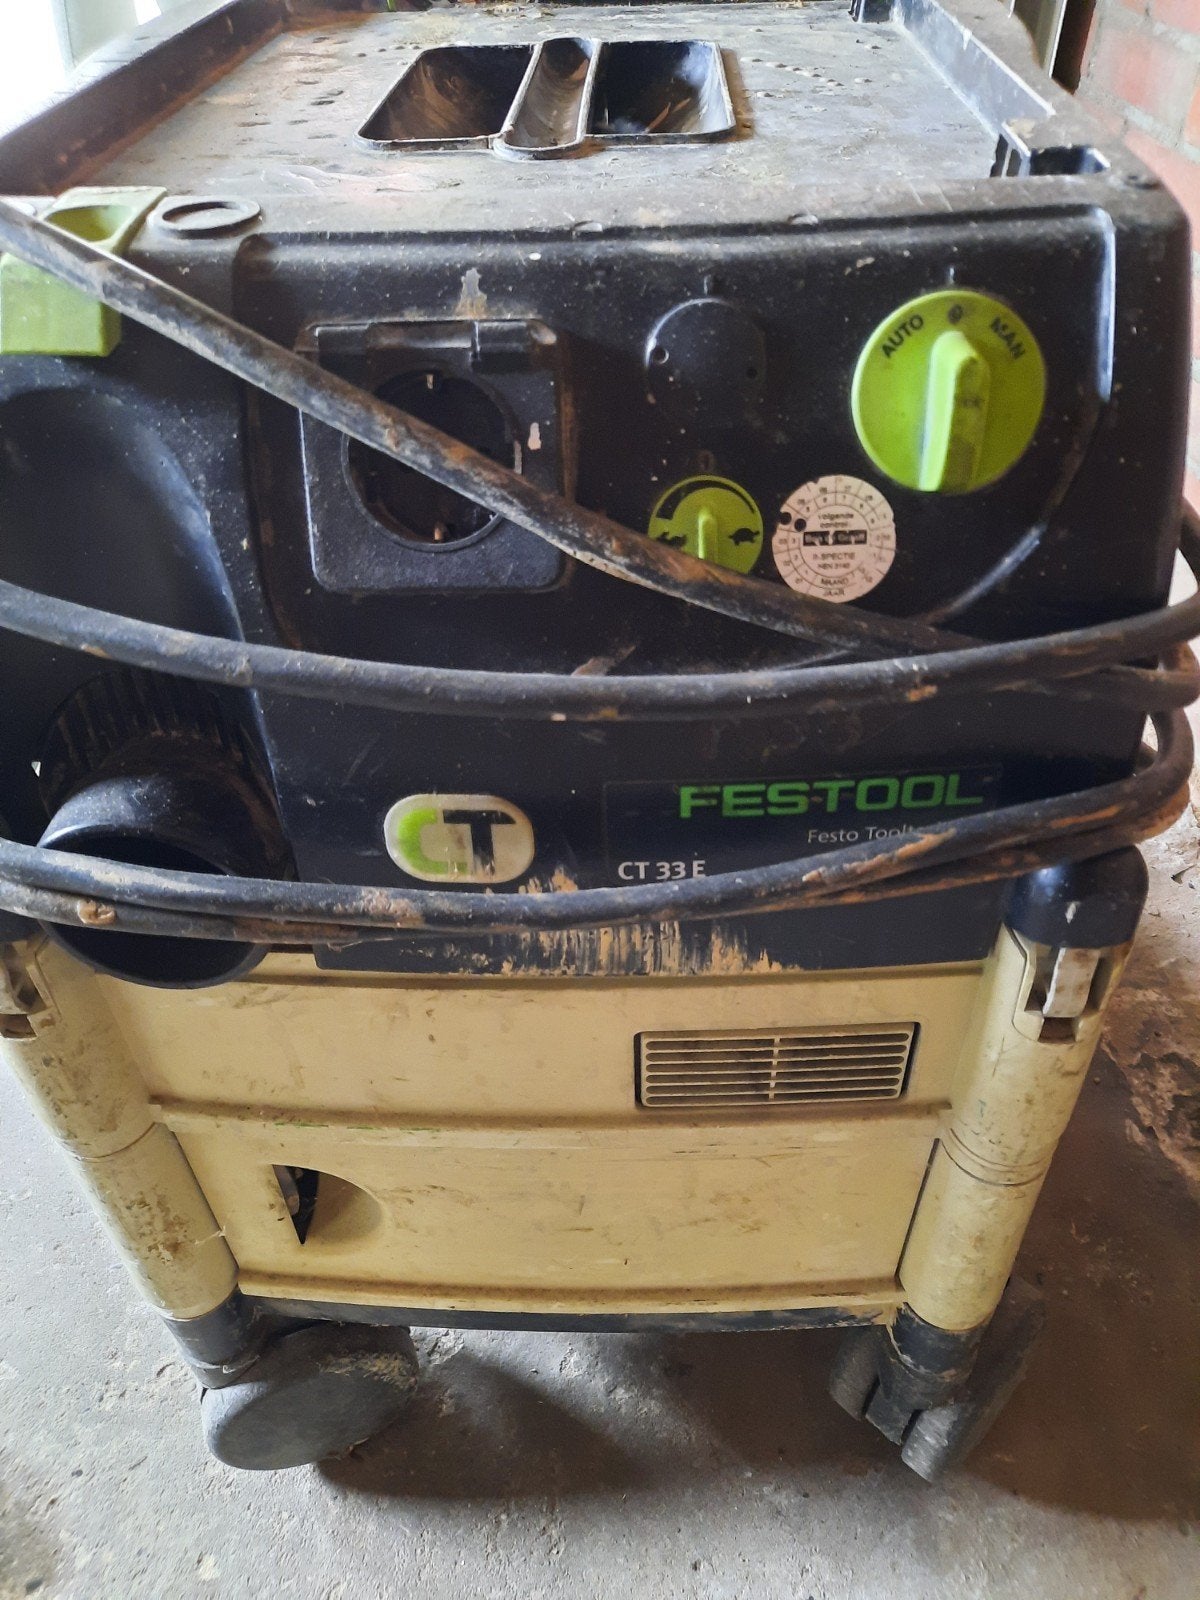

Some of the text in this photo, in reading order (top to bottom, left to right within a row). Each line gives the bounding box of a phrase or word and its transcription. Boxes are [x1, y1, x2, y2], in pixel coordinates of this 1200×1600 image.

[881, 314, 924, 359] AUTO
[989, 317, 1026, 360] MAN
[679, 774, 983, 819] FESTOOL
[398, 808, 517, 876] CT
[807, 829, 859, 844] Festo
[617, 859, 706, 880] CT 33 E
